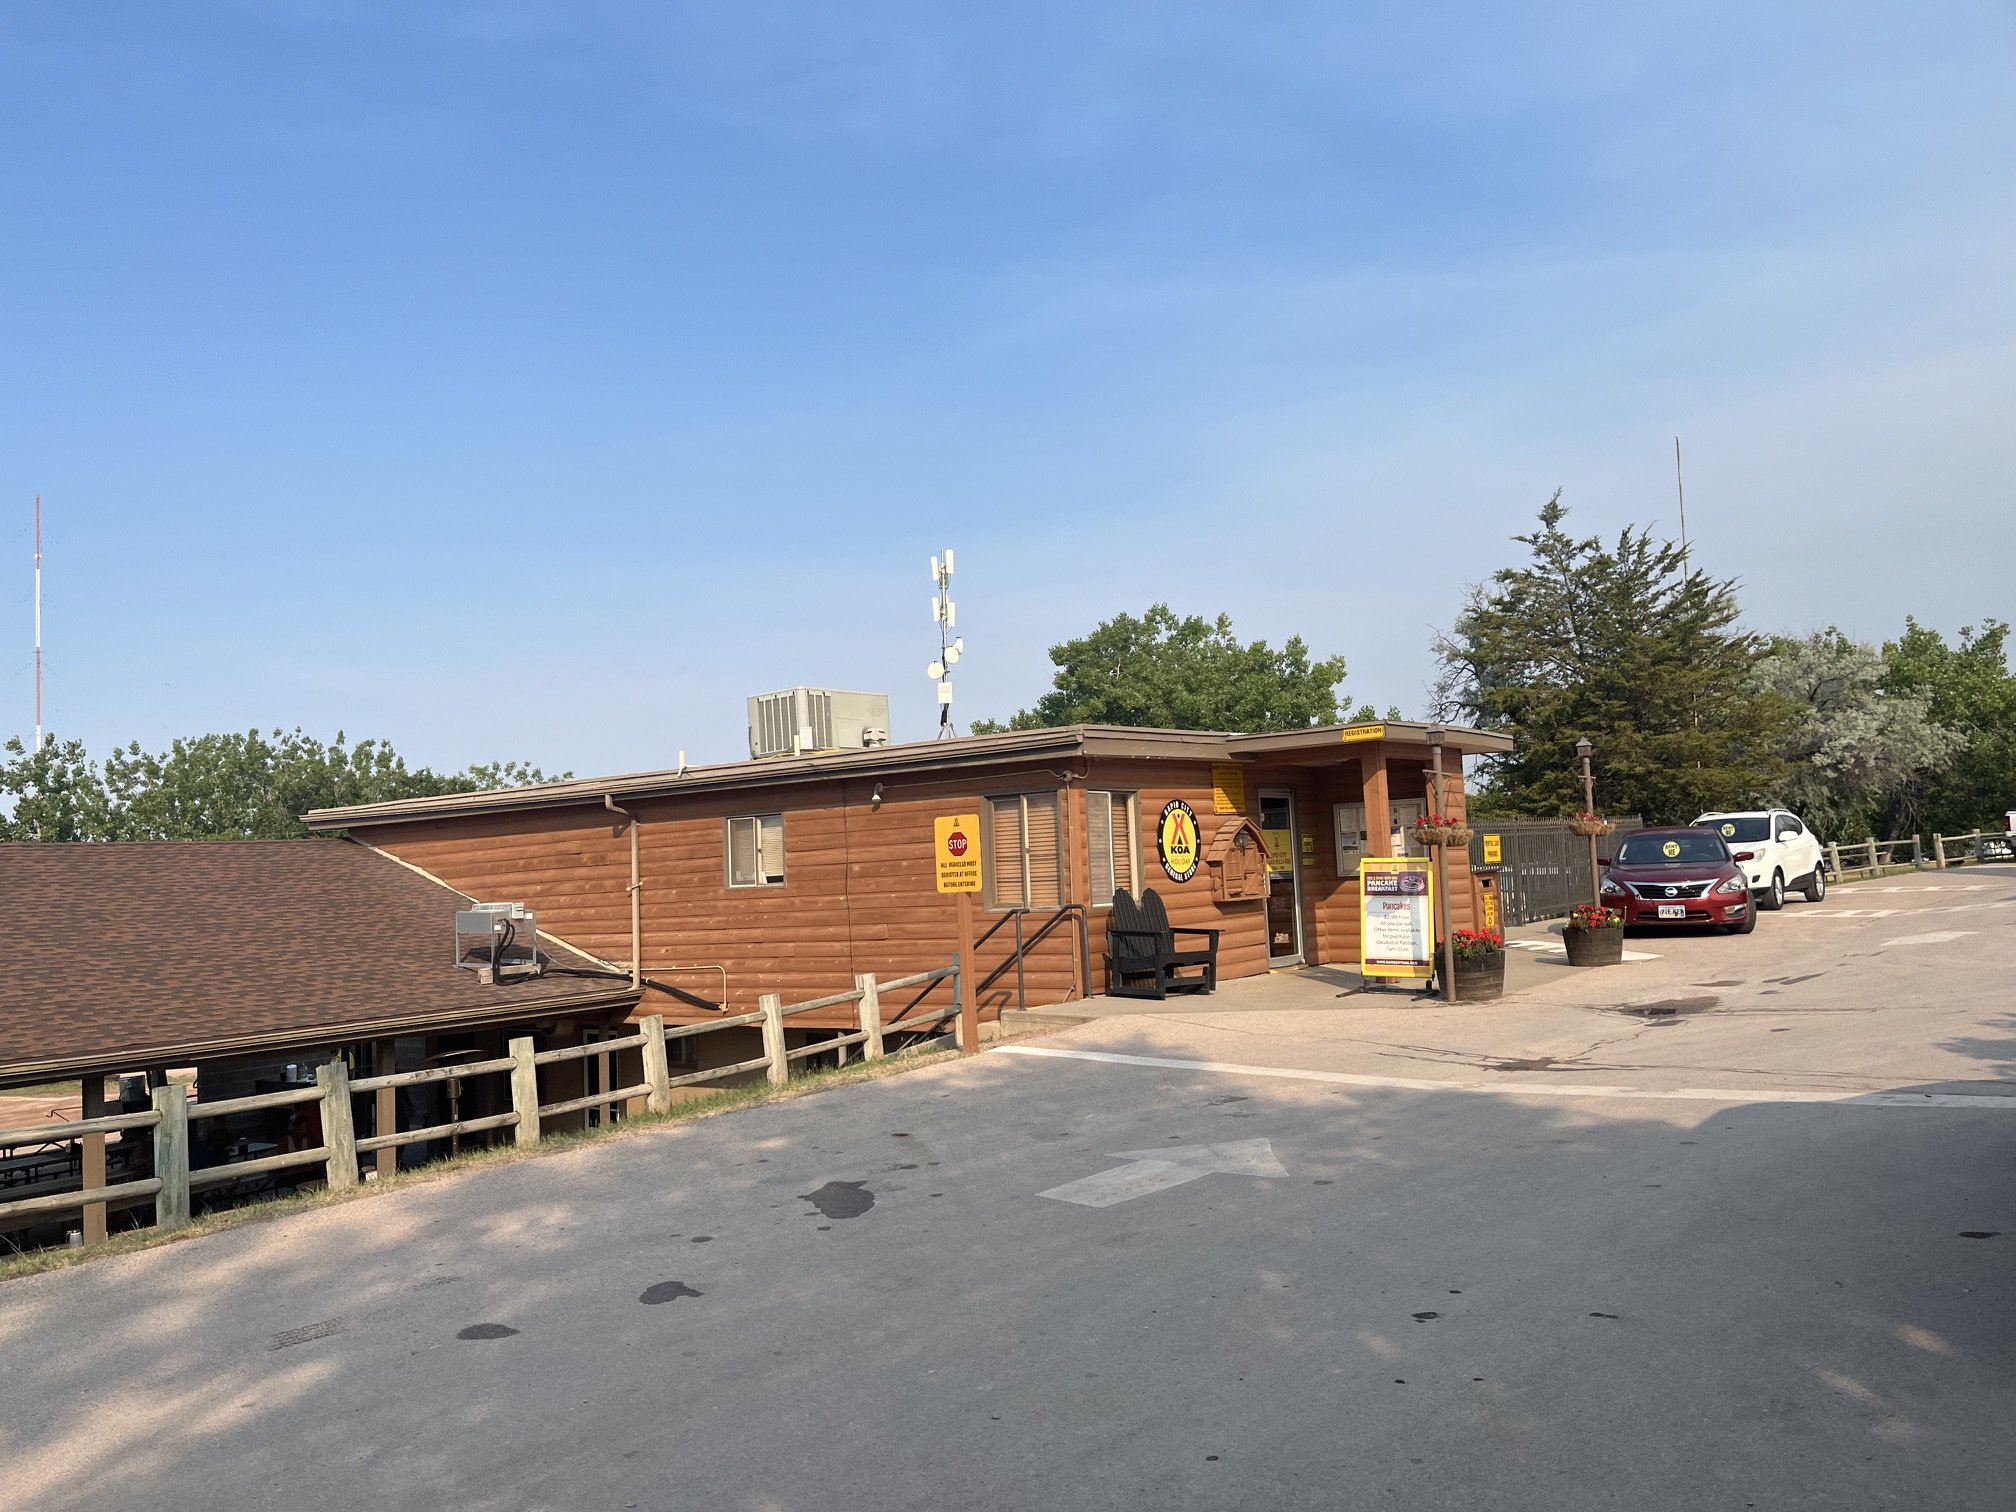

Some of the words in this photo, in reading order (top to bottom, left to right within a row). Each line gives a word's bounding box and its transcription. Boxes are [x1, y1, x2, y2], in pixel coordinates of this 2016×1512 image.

[1344, 727, 1382, 736] REGISTRATION
[1164, 800, 1179, 816] RAPID
[1181, 802, 1193, 817] CITY
[948, 839, 967, 850] STOP
[1170, 845, 1190, 854] KOA
[1170, 857, 1191, 865] HOLIDAY
[1164, 862, 1184, 881] GENERAL
[1184, 863, 1197, 880] STORE
[957, 880, 976, 888] ENTERING
[1382, 901, 1410, 911] Pancakes
